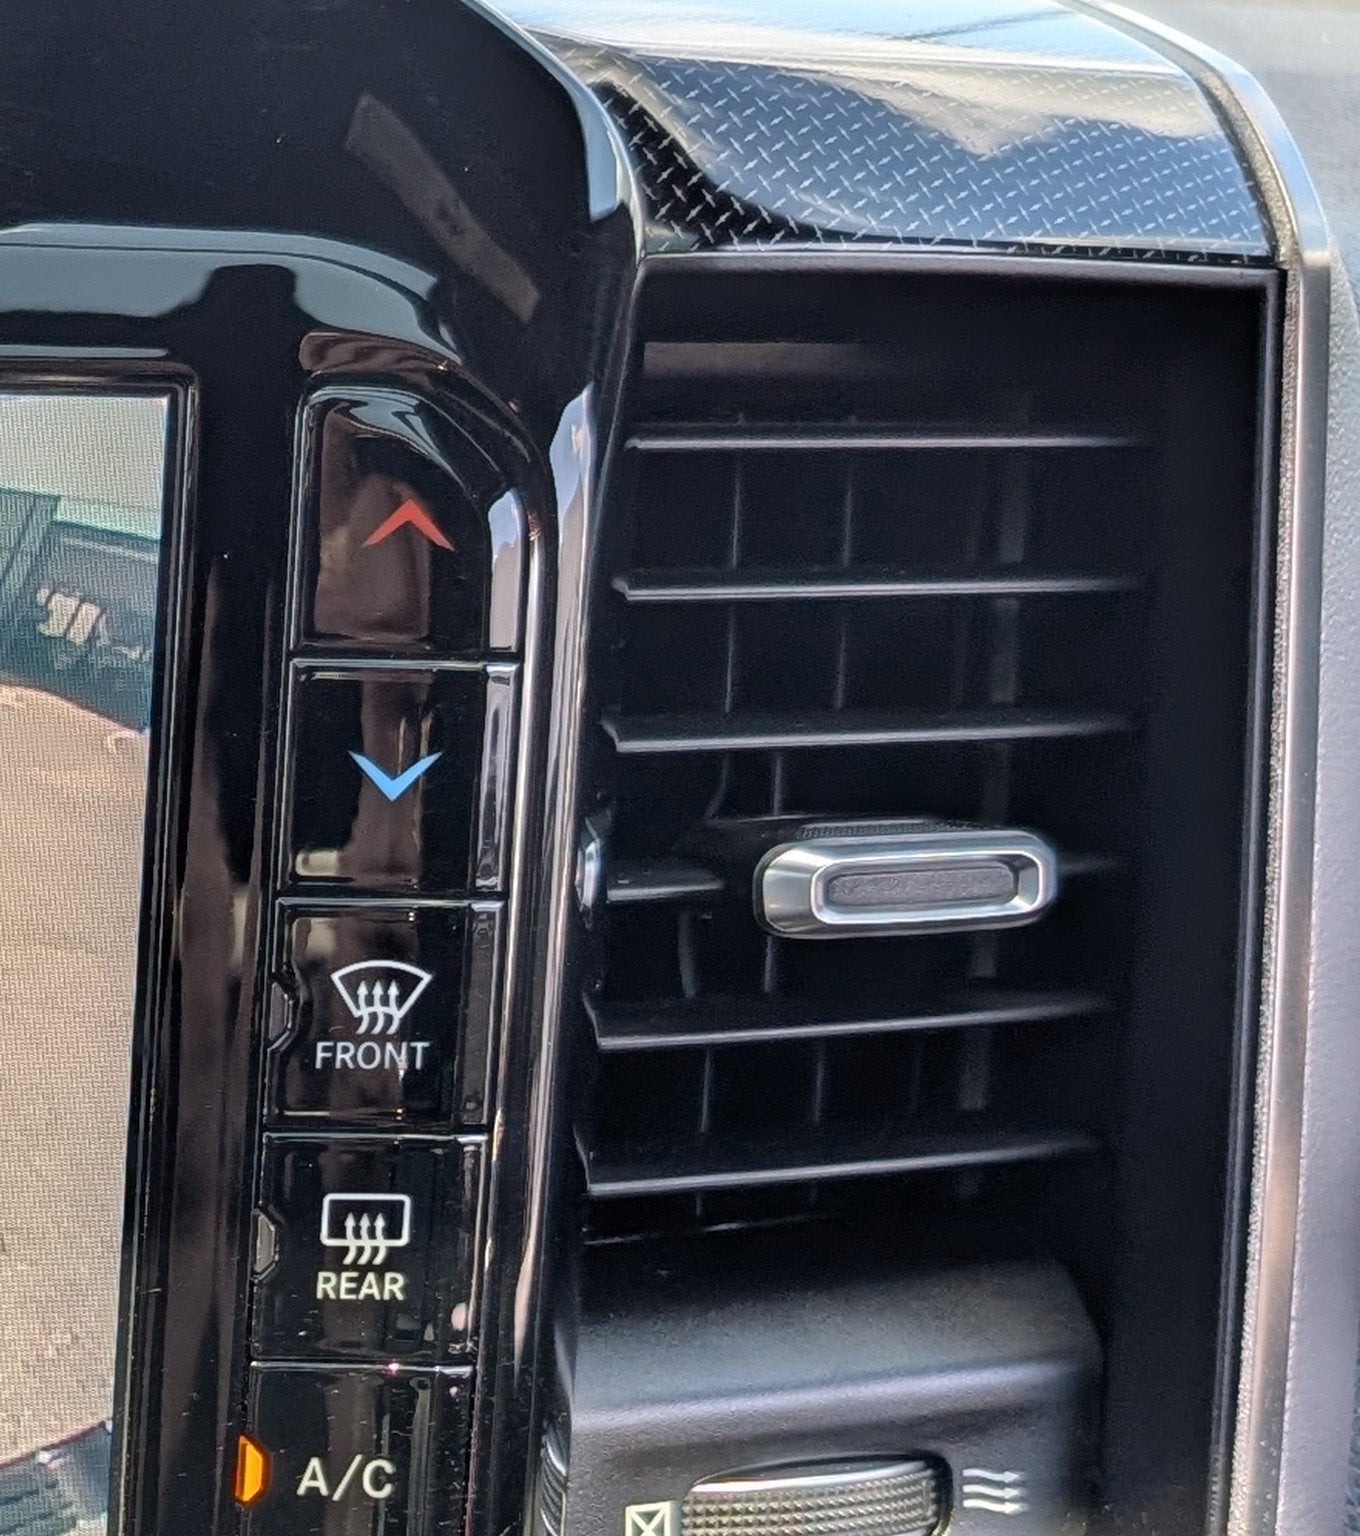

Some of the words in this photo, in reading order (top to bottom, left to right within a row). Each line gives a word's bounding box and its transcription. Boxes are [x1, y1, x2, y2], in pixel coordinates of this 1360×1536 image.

[315, 1041, 430, 1070] FRONT
[316, 1271, 405, 1300] REAR
[296, 1453, 397, 1501] A/C
